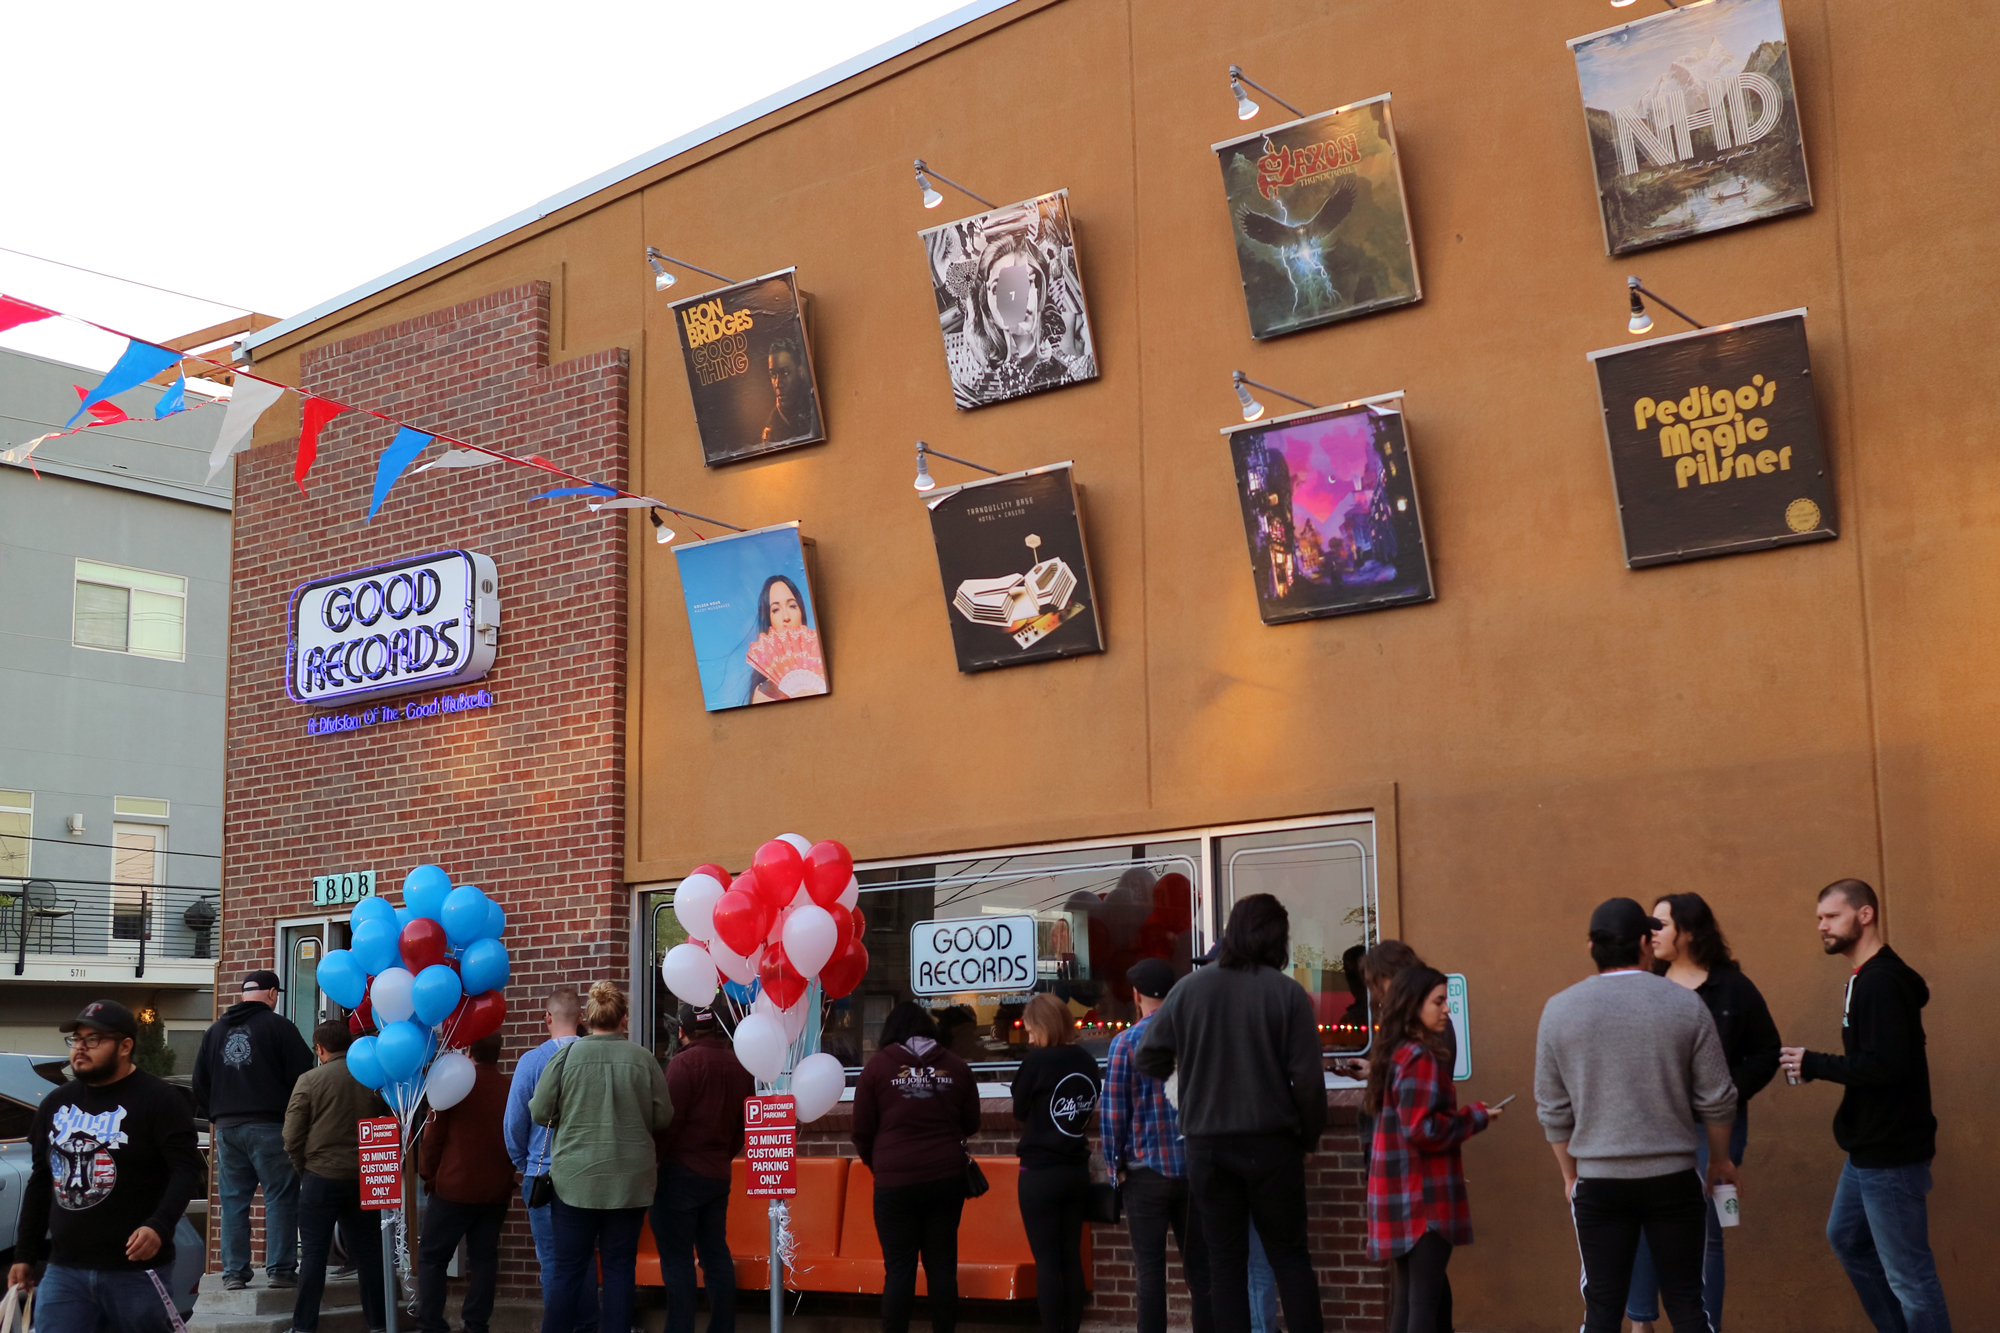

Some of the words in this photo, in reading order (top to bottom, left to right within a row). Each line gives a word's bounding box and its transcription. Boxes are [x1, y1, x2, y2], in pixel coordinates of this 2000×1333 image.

[1612, 71, 1783, 176] NHD
[1257, 133, 1361, 200] SAXON
[1009, 290, 1016, 301] 7
[681, 297, 725, 328] LEON
[687, 308, 754, 348] BRIDGES
[692, 331, 748, 367] GOOD
[696, 352, 749, 386] THING
[1634, 373, 1777, 431] Pedigo's
[1659, 412, 1769, 460] Magic
[1675, 445, 1793, 489] Pilsner
[966, 501, 1012, 516] TRANQUILITY
[1015, 497, 1034, 507] BASE
[978, 514, 996, 523] HOTEL
[1004, 508, 1026, 518] CASINO
[321, 568, 442, 634] GOOD
[302, 617, 459, 693] RECORDS
[319, 713, 361, 734] Division
[363, 708, 380, 725] Of
[381, 706, 400, 722] The
[405, 697, 439, 719] Good
[312, 874, 369, 902] 1808
[933, 924, 1012, 954] GOOD
[70, 968, 86, 978] 5711
[920, 955, 1028, 986] RECORDS
[84, 1002, 103, 1017] T
[891, 1077, 906, 1086] THE
[936, 1076, 953, 1084] TREE
[749, 1104, 760, 1120] P
[763, 1102, 794, 1111] CUSTOMER
[1053, 1097, 1077, 1121] City
[763, 1111, 787, 1119] PARKING
[361, 1126, 370, 1140] P
[372, 1123, 397, 1131] CUSTOMER
[748, 1135, 758, 1146] 30
[759, 1134, 792, 1145] MINUTE
[361, 1153, 370, 1162] 30
[371, 1151, 397, 1161] MINUTE
[747, 1147, 794, 1159] CUSTOMER
[361, 1162, 399, 1173] CUSTOMER
[752, 1160, 789, 1172] PARKING
[365, 1174, 395, 1185] PARKING
[759, 1174, 782, 1185] ONLY
[372, 1186, 390, 1196] ONLY
